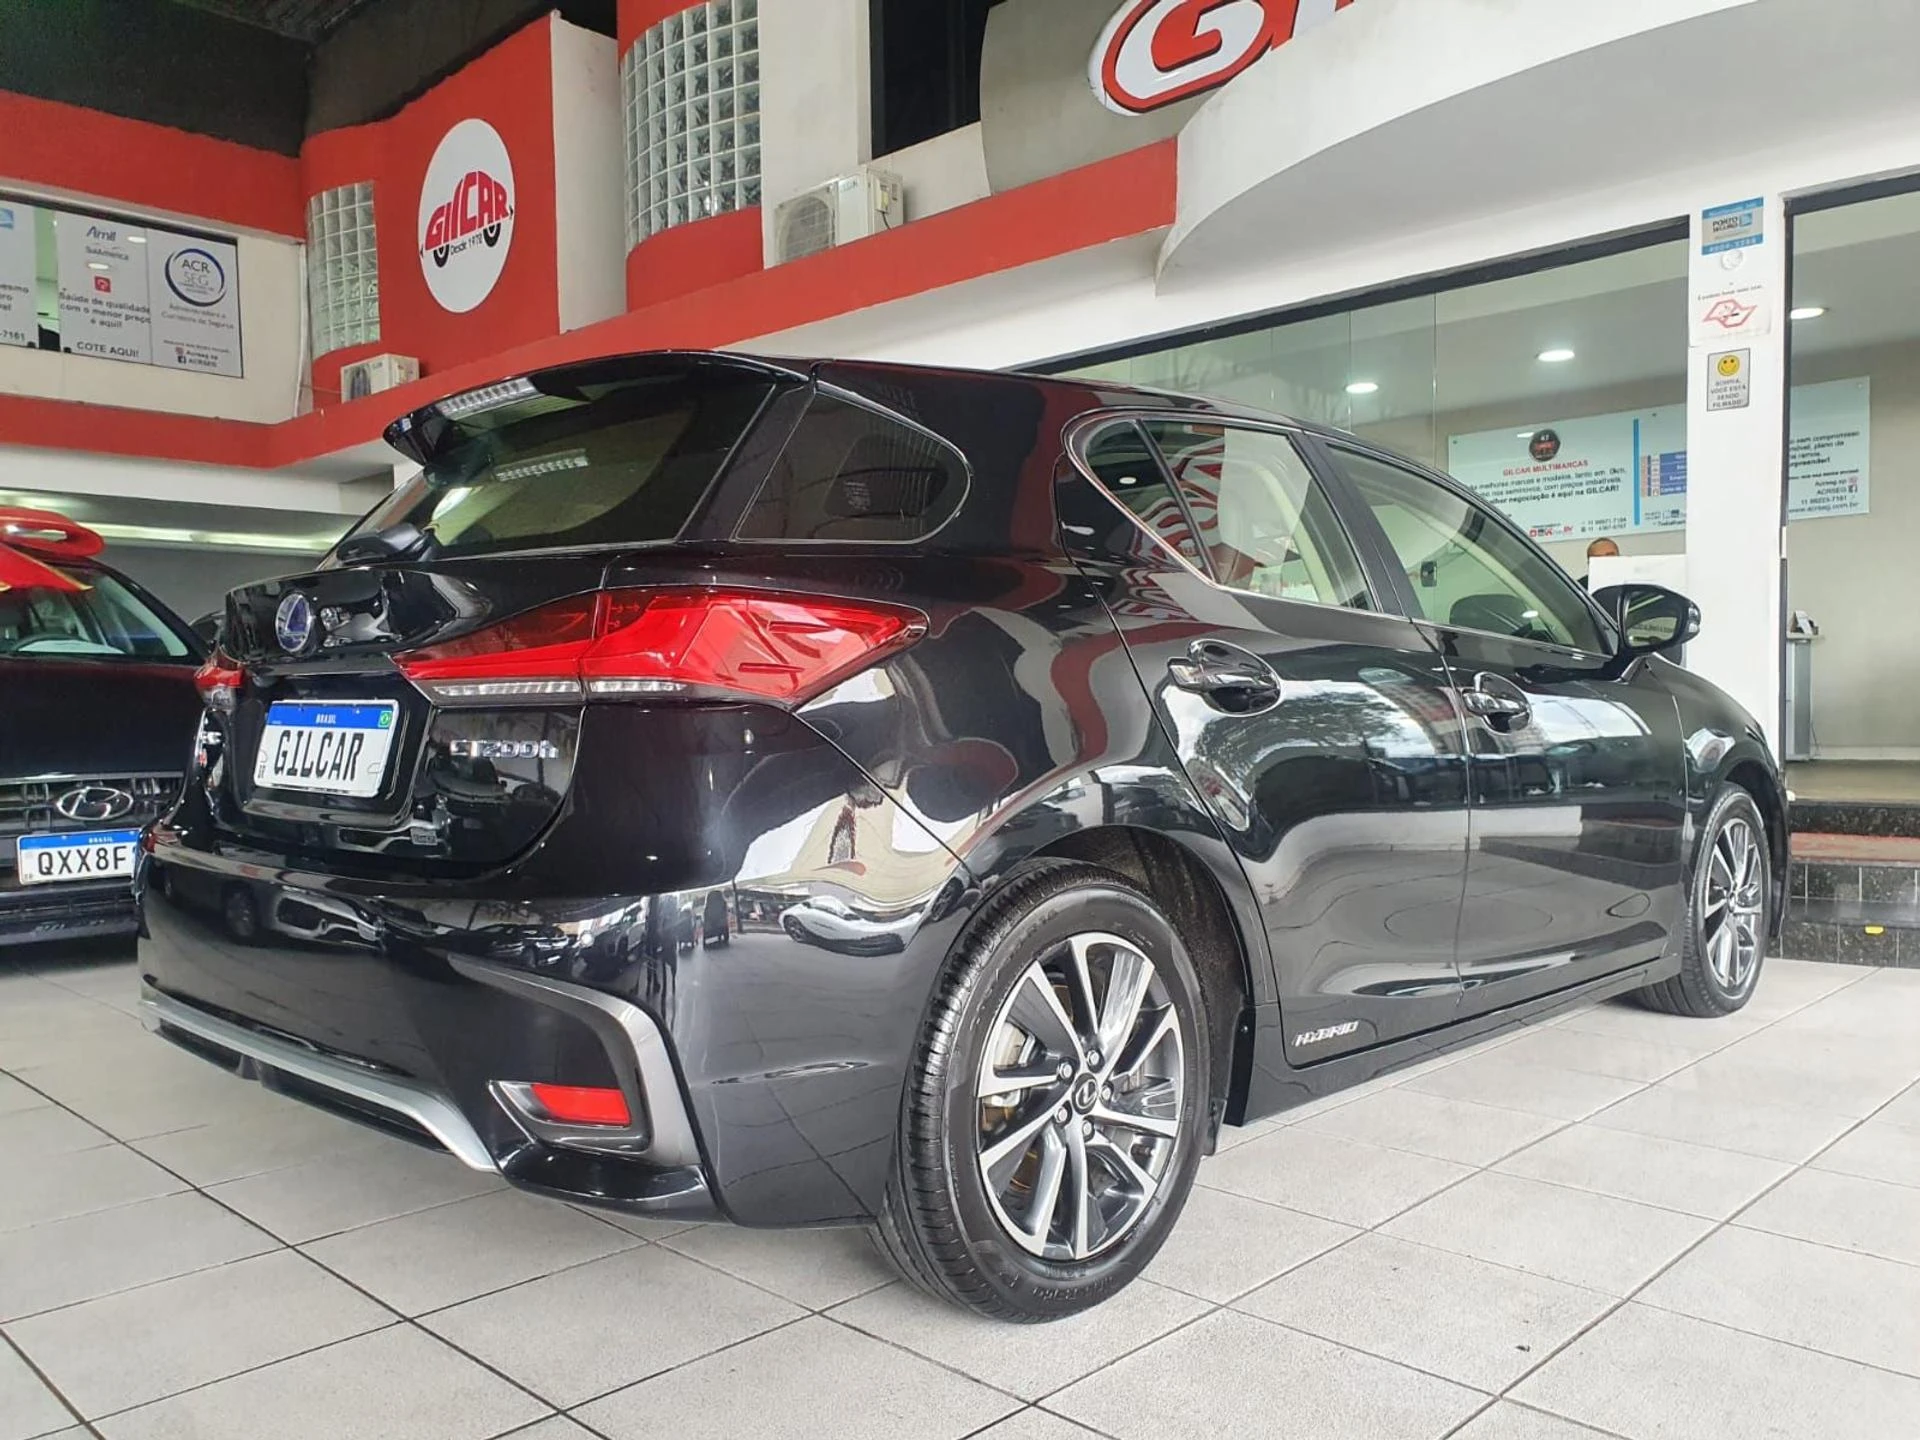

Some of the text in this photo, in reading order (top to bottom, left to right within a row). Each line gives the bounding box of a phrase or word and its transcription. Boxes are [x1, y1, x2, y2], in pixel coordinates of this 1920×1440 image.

[425, 170, 510, 251] GILCAR
[181, 259, 210, 273] ACR
[77, 341, 107, 353] COTE
[1533, 460, 1589, 473] MULTIMARCAS
[273, 729, 364, 782] GILCAR
[38, 845, 135, 875] QXX8F
[1291, 1020, 1359, 1048] HYBRID
